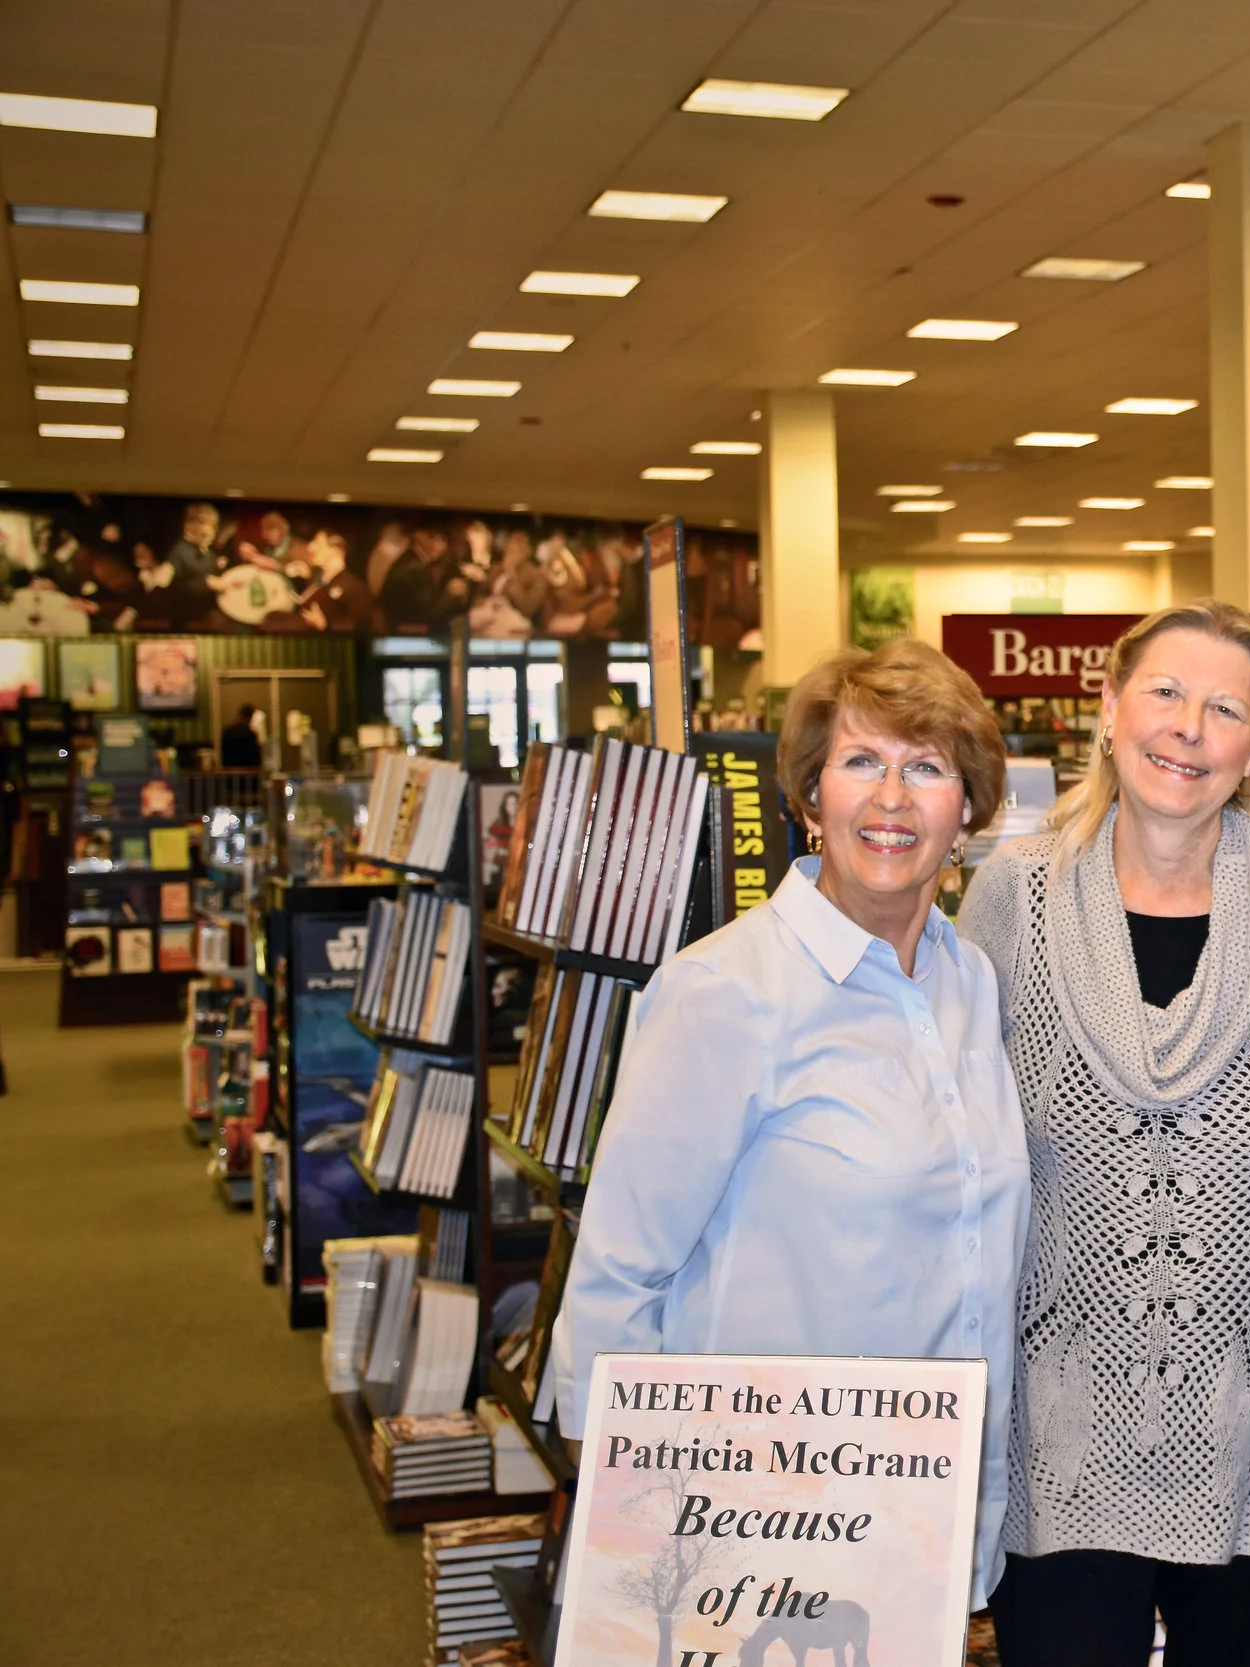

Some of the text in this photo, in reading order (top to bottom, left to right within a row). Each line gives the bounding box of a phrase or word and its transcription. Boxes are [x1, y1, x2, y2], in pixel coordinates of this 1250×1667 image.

[989, 628, 1107, 693] Barg
[722, 752, 768, 918] JAMES BO
[609, 1381, 961, 1421] MEET the AUTHOR
[604, 1435, 953, 1480] Patricia McGrane
[669, 1494, 872, 1543] Because
[696, 1575, 830, 1628] of the
